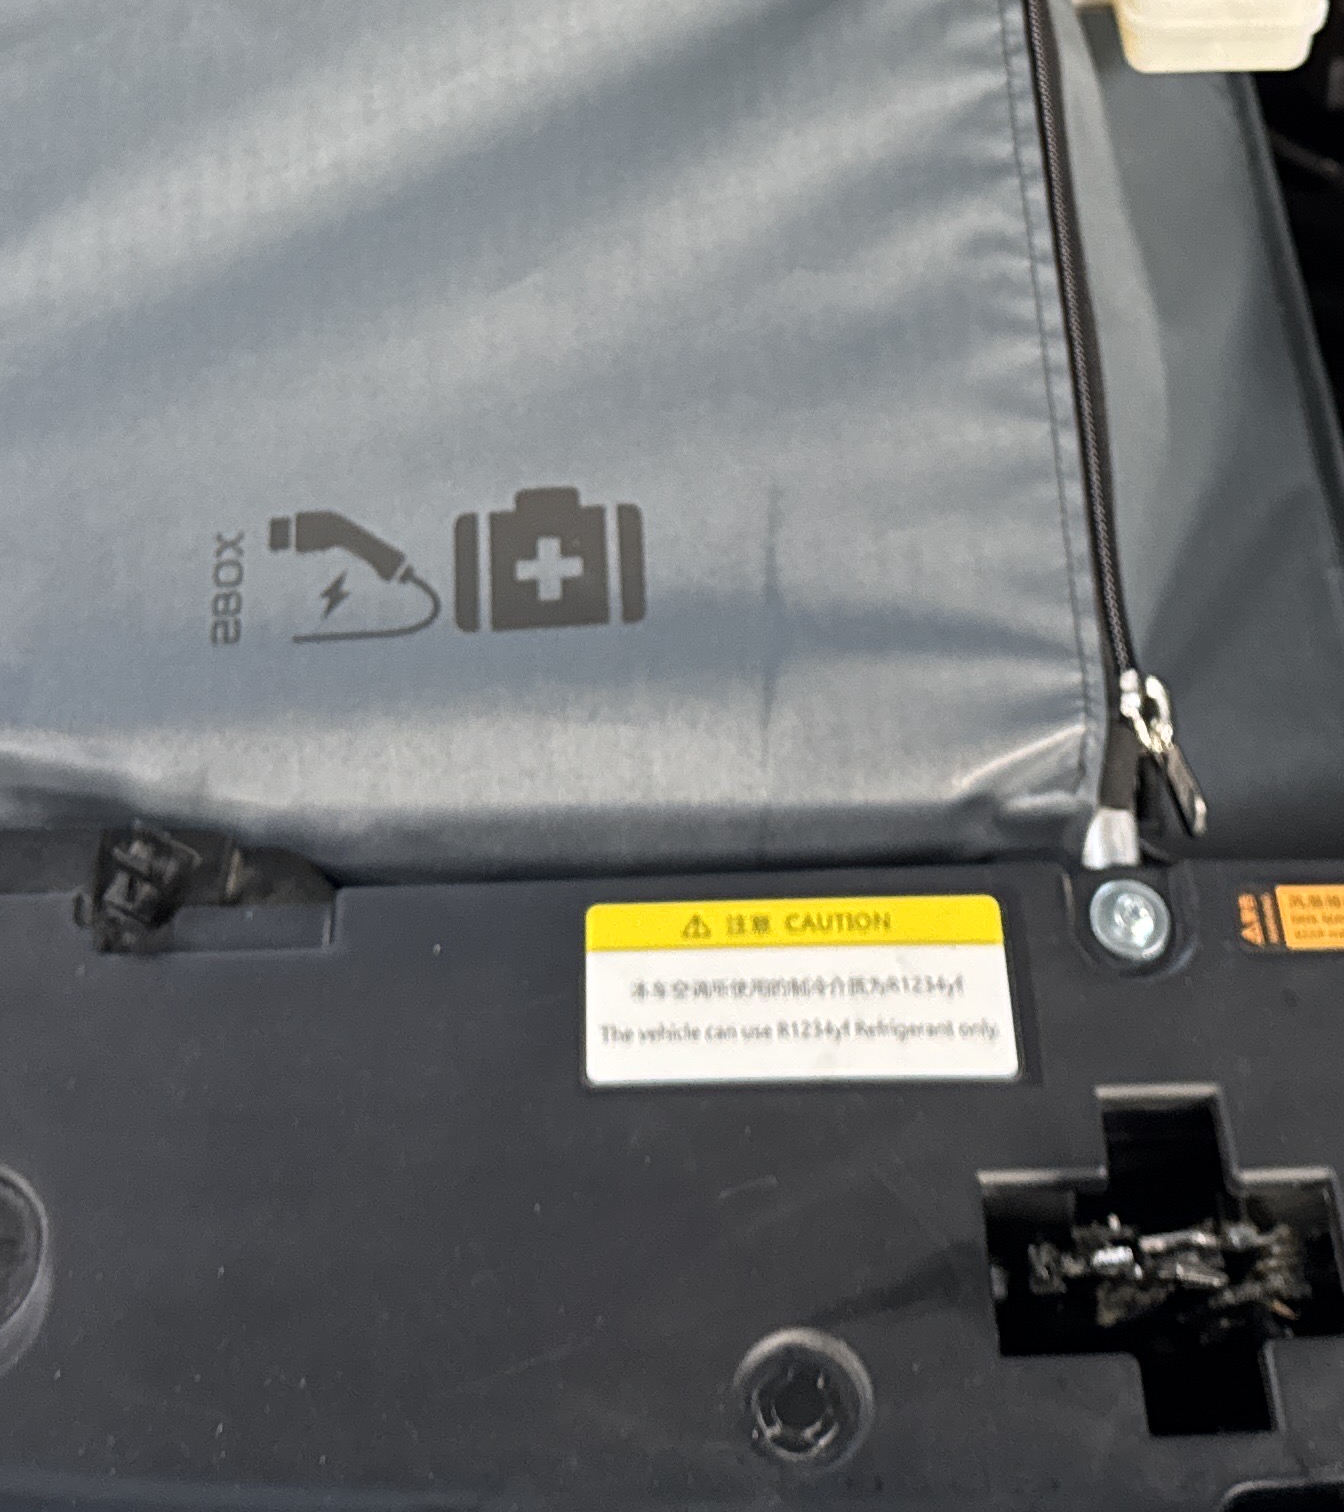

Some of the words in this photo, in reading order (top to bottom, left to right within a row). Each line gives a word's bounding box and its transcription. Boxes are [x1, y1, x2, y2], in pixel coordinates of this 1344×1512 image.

[784, 911, 892, 934] CAUTION
[601, 1022, 634, 1043] The
[638, 1021, 701, 1041] vehicle
[705, 1022, 738, 1041] can
[741, 1023, 773, 1040] use
[778, 1018, 850, 1045] R1234yf
[855, 1014, 955, 1042] Refrigerant
